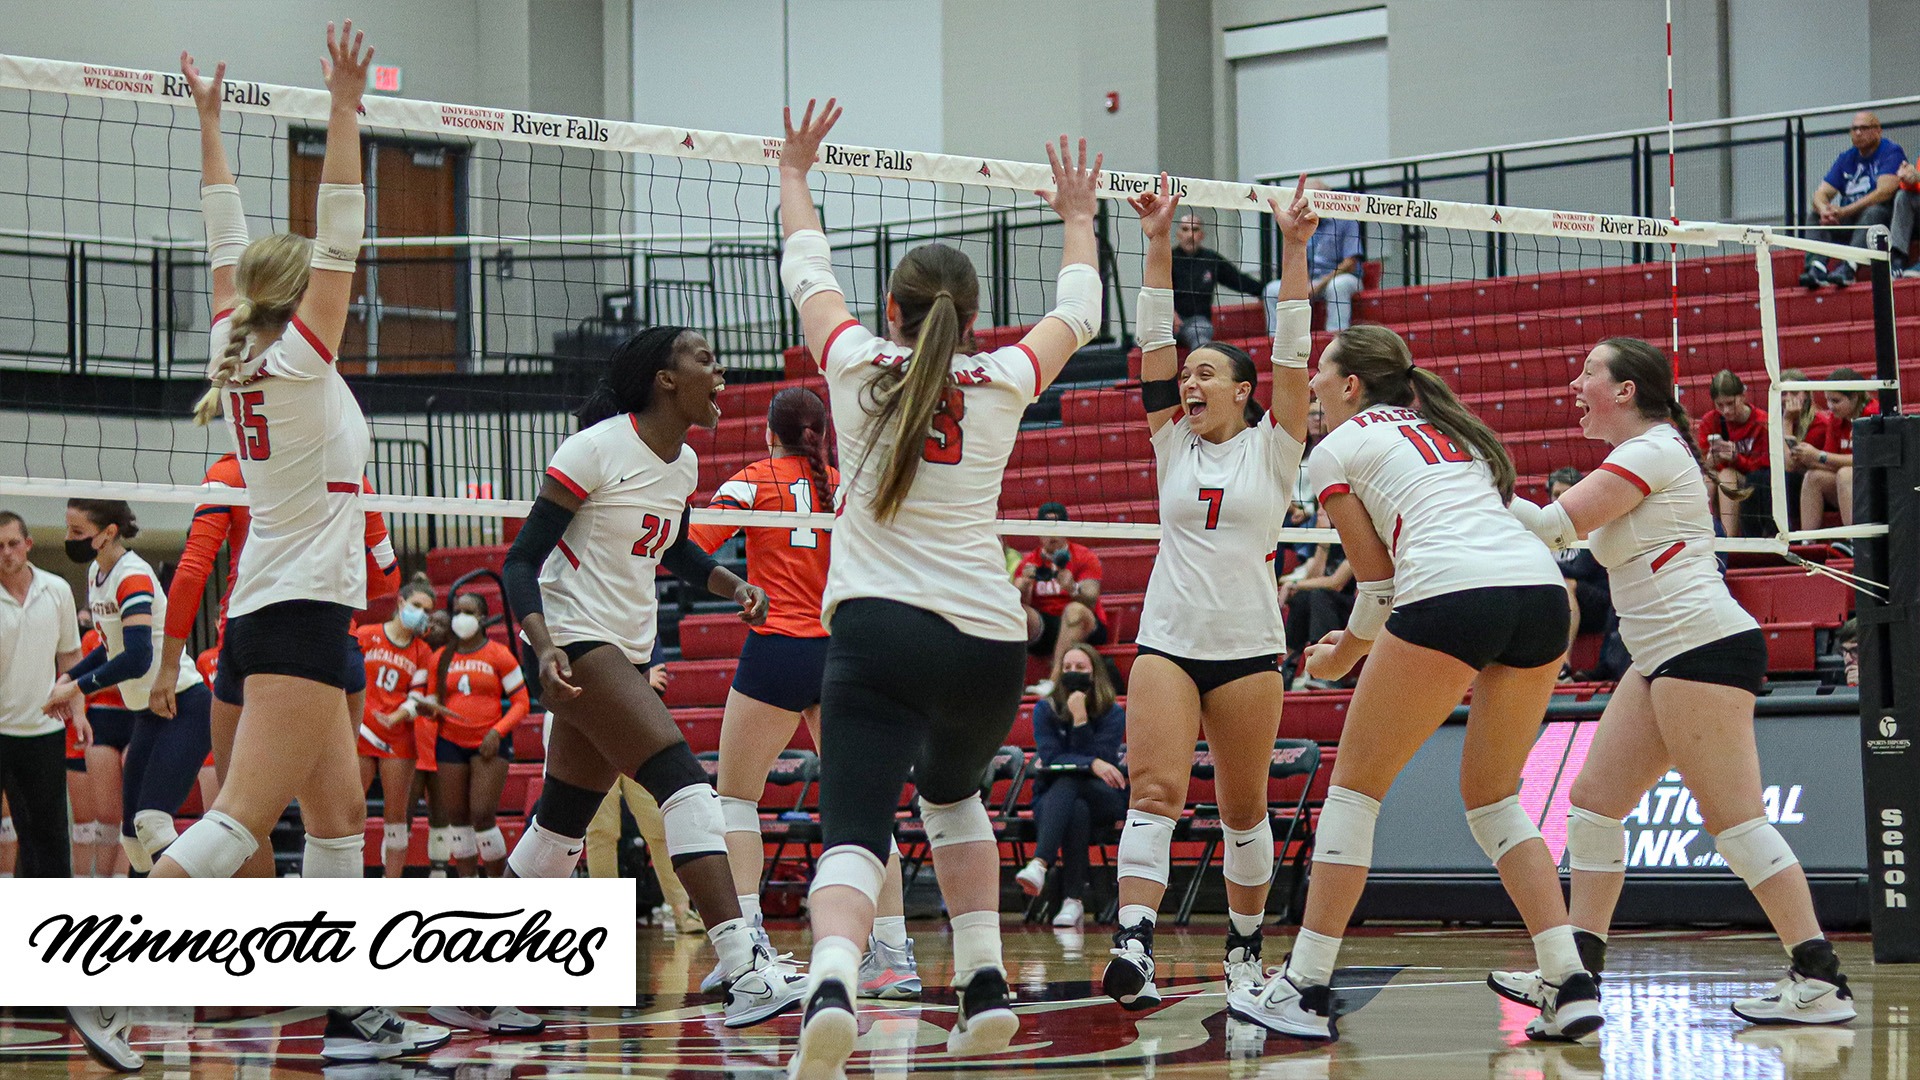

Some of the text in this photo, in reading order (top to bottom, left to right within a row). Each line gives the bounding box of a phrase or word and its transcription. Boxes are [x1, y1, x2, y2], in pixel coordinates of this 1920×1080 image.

[83, 66, 154, 81] UNIVERSITY OF
[83, 77, 154, 94] WISCONSIN
[161, 74, 271, 107] Riv Falls
[441, 105, 505, 120] UNIVERSITY OF
[441, 115, 505, 132] WISCONSIN
[511, 112, 609, 142] River Falls
[825, 144, 913, 172] River Falls
[1109, 172, 1149, 194] River
[1153, 176, 1188, 198] Flls
[1313, 192, 1352, 202] UNIVERSITY
[1313, 200, 1360, 213] WISCONSIN
[1365, 196, 1438, 220] River Falls
[1552, 212, 1588, 222] UNIVERSITY
[1552, 221, 1595, 232] WISCONSIN
[1599, 216, 1669, 237] River Falls
[871, 353, 993, 386] FANS
[229, 390, 272, 461] 15
[1351, 408, 1421, 428] FALC
[1397, 423, 1474, 465] 18
[1198, 487, 1225, 530] 7
[631, 513, 672, 559] 21
[375, 665, 400, 692] 19
[457, 673, 472, 697] 4
[1623, 829, 1700, 867] NK
